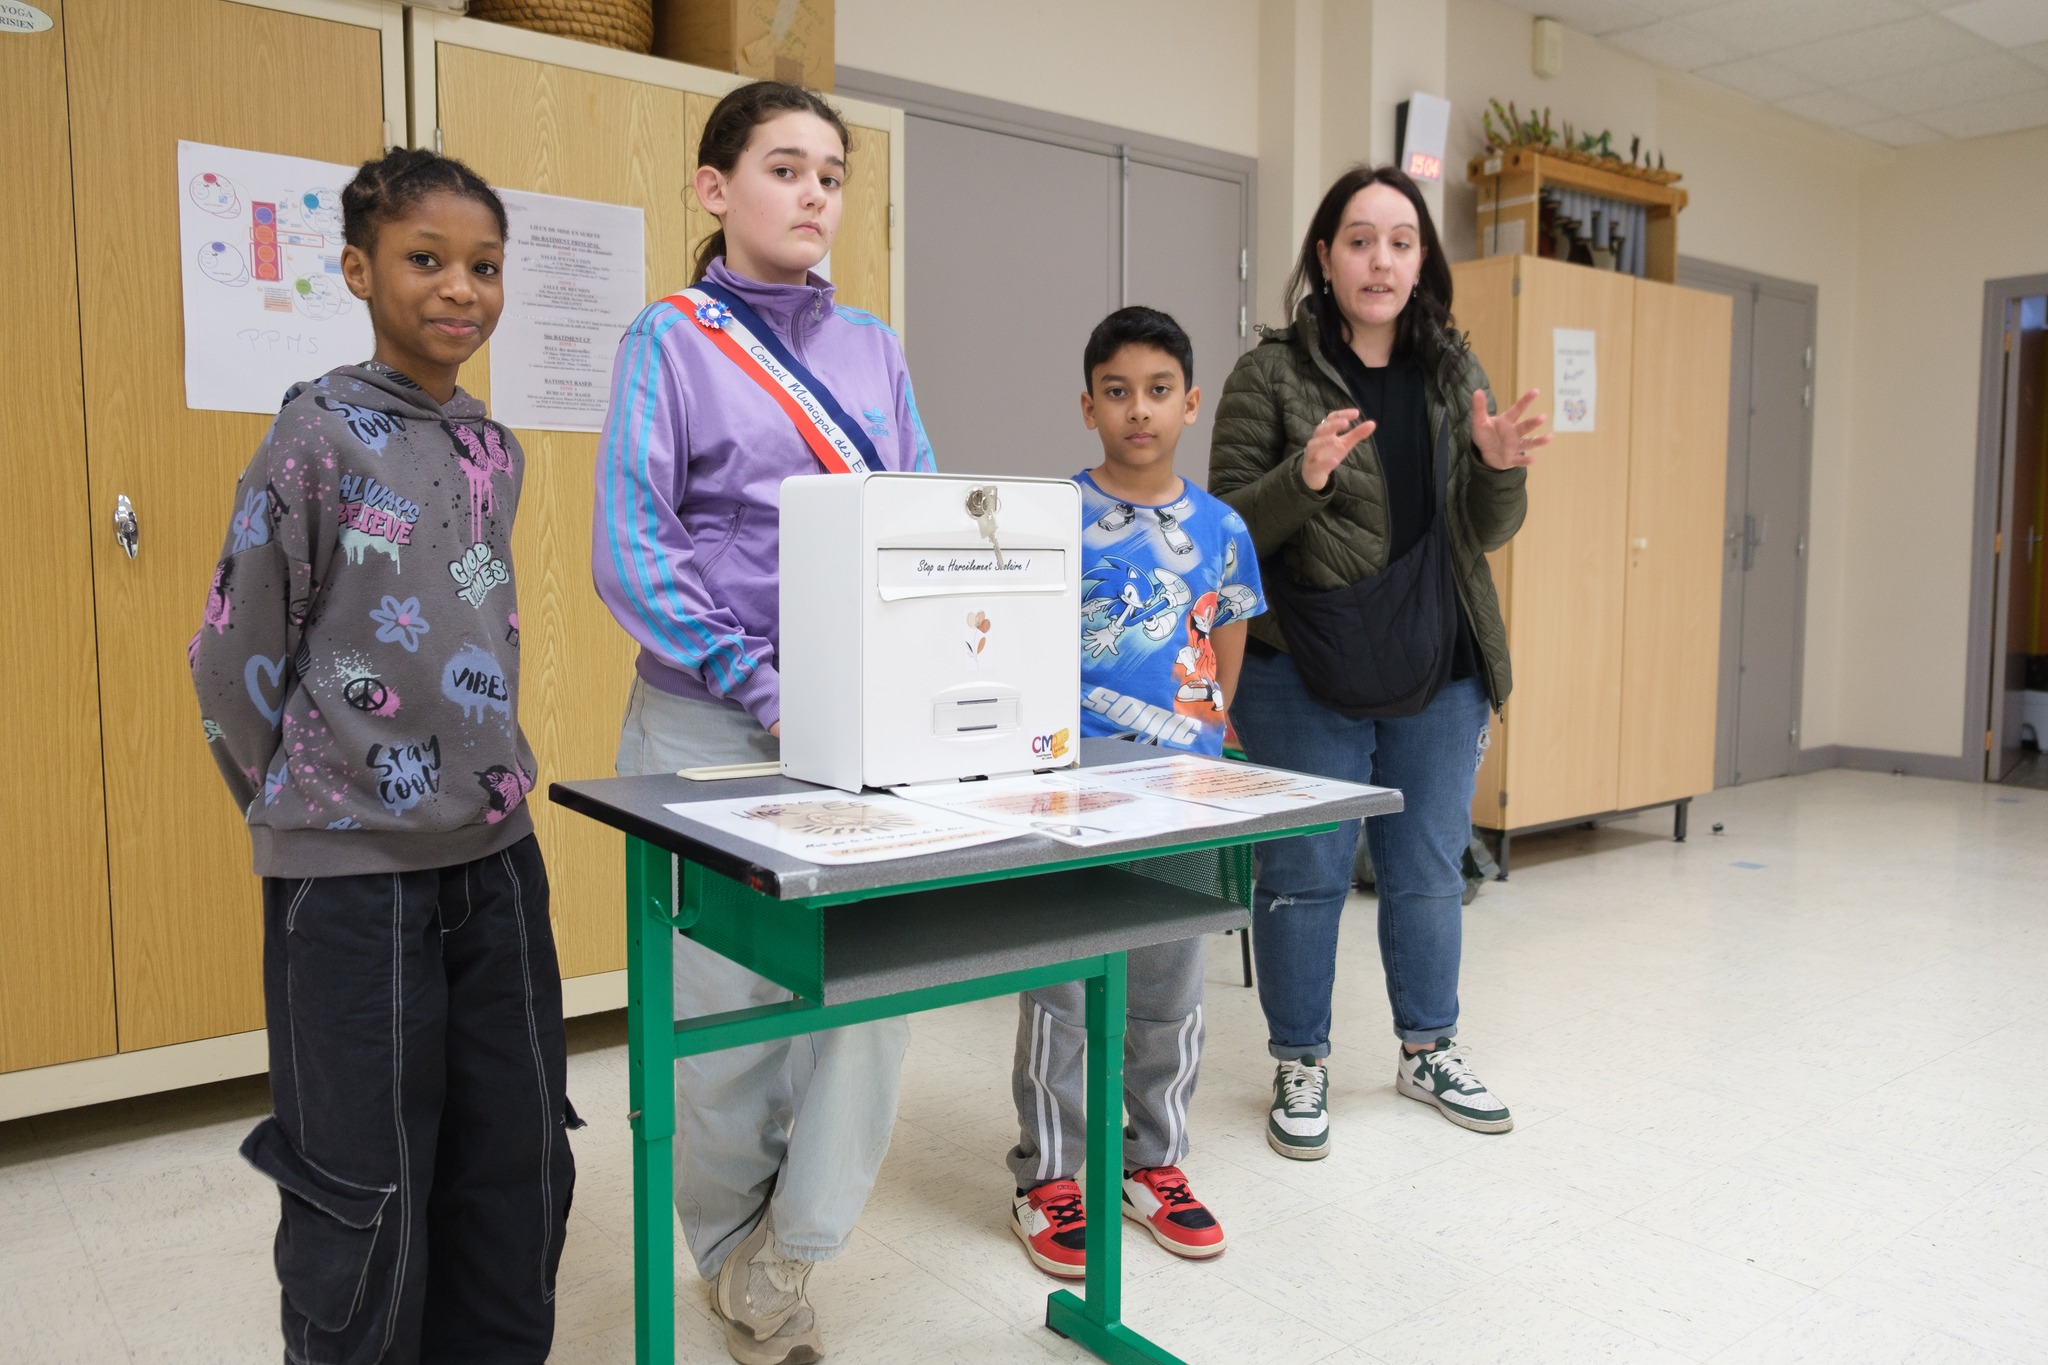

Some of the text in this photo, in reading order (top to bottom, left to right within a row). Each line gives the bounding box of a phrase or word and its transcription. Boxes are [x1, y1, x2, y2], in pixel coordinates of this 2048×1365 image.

[0, 4, 33, 19] YOGA
[237, 328, 319, 355] PPMS
[750, 344, 789, 383] Conseil
[787, 382, 837, 437] Municipal
[834, 438, 852, 459] des
[340, 473, 420, 523] ALWAYS
[455, 557, 508, 608] TIMES
[917, 558, 934, 576] Stop
[936, 564, 945, 572] au
[947, 558, 992, 572] Harcèlement
[994, 558, 1023, 572] Solaire
[366, 735, 441, 778] Stay
